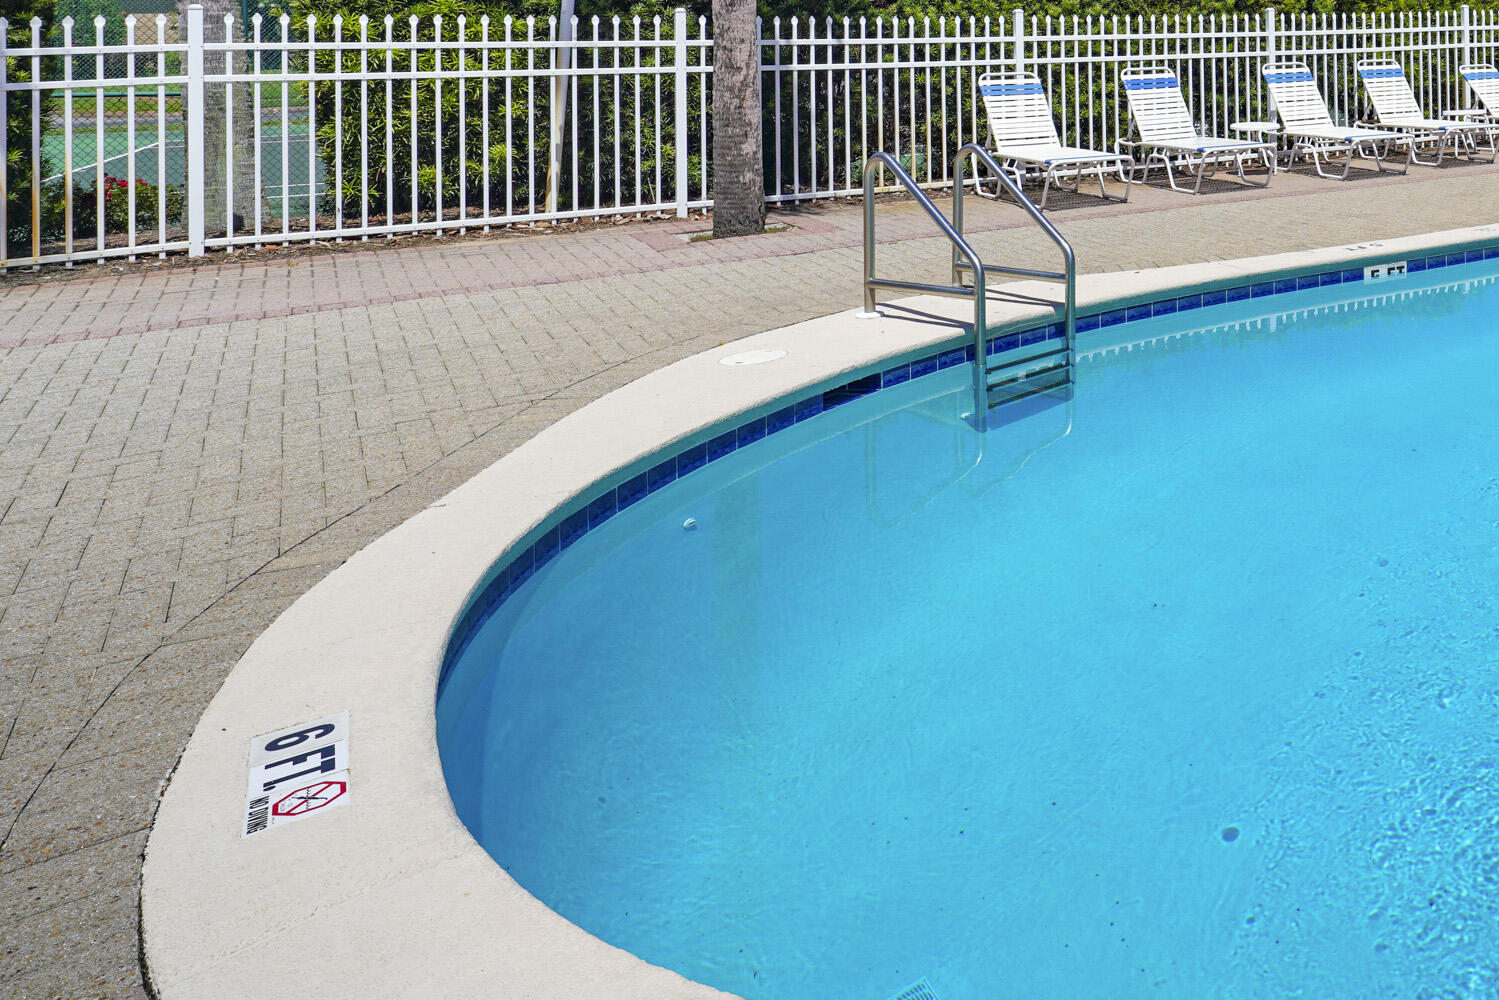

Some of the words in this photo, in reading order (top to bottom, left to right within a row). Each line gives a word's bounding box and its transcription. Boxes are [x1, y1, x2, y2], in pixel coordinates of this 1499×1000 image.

[264, 723, 335, 752] 6
[249, 795, 270, 810] NO
[246, 806, 269, 835] DIVING
